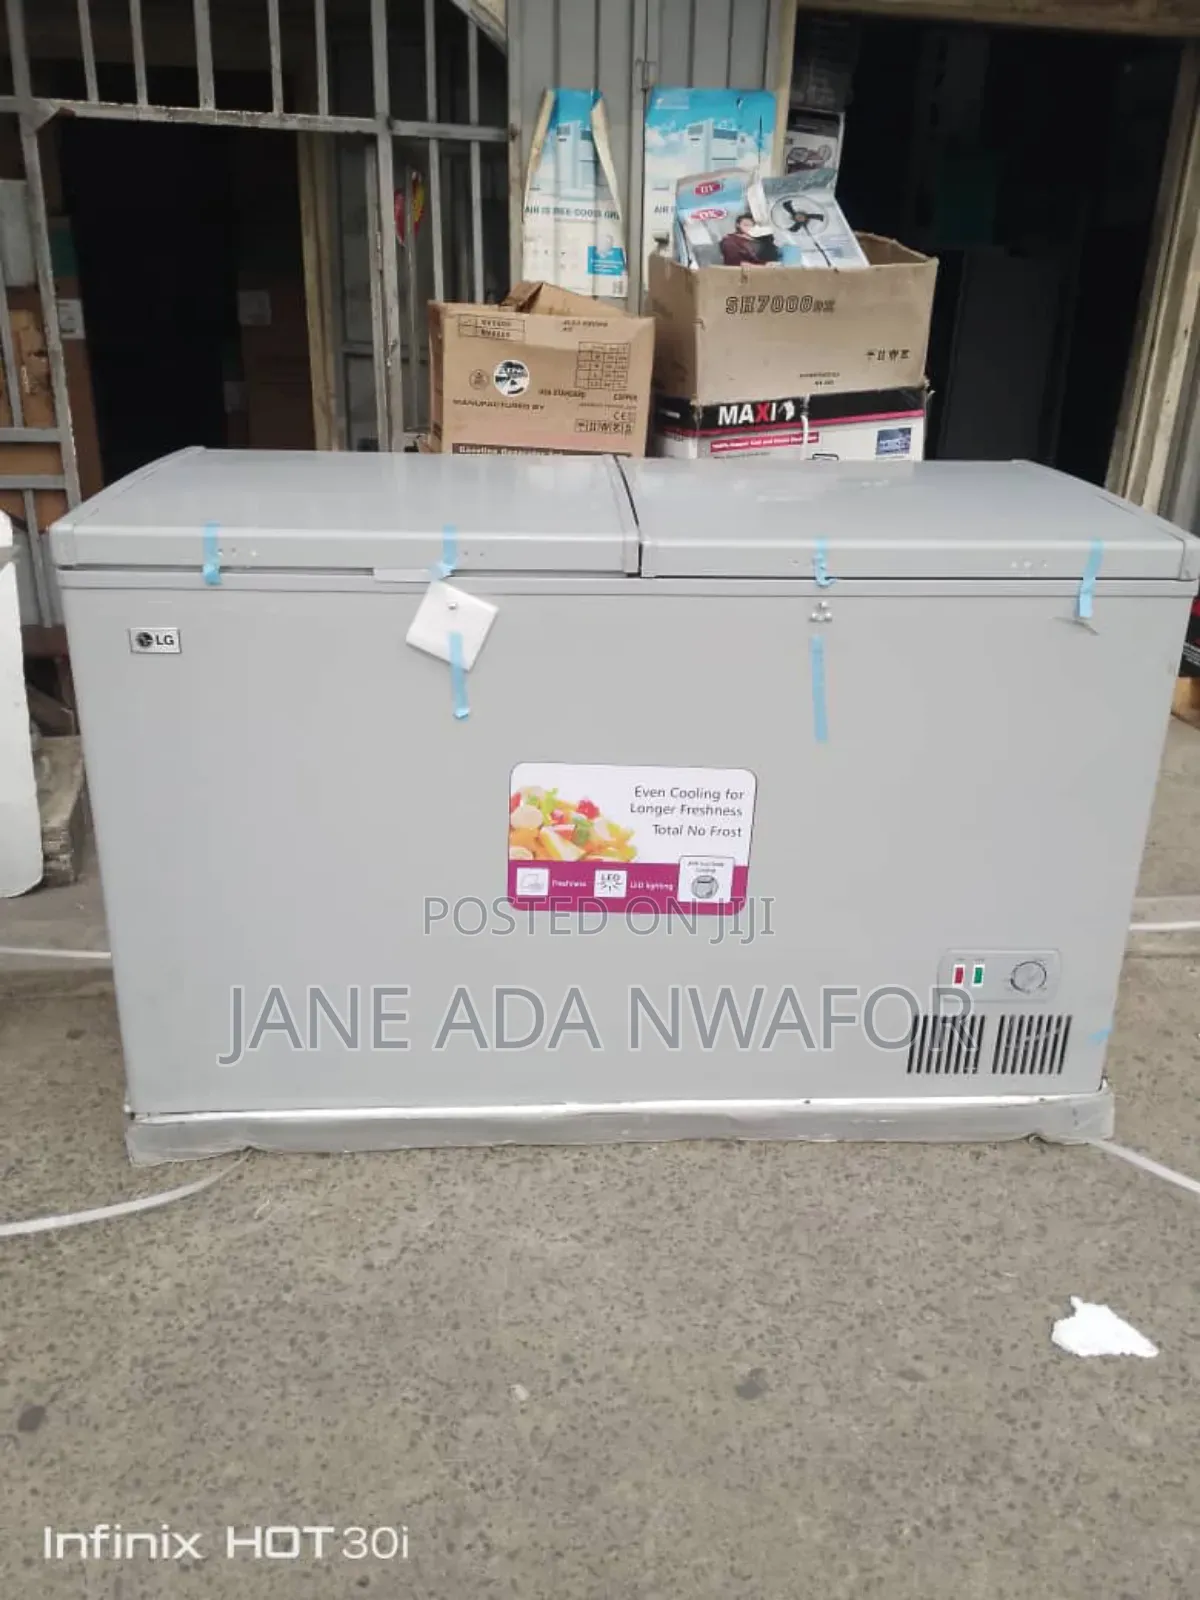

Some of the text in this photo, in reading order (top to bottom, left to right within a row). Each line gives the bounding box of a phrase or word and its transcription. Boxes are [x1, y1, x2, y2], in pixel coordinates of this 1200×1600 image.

[717, 402, 777, 426] MAXI
[156, 634, 174, 646] LG
[634, 785, 745, 803] Even Cooling for
[630, 802, 743, 818] Longer Freshness
[652, 823, 743, 838] Total No Frost
